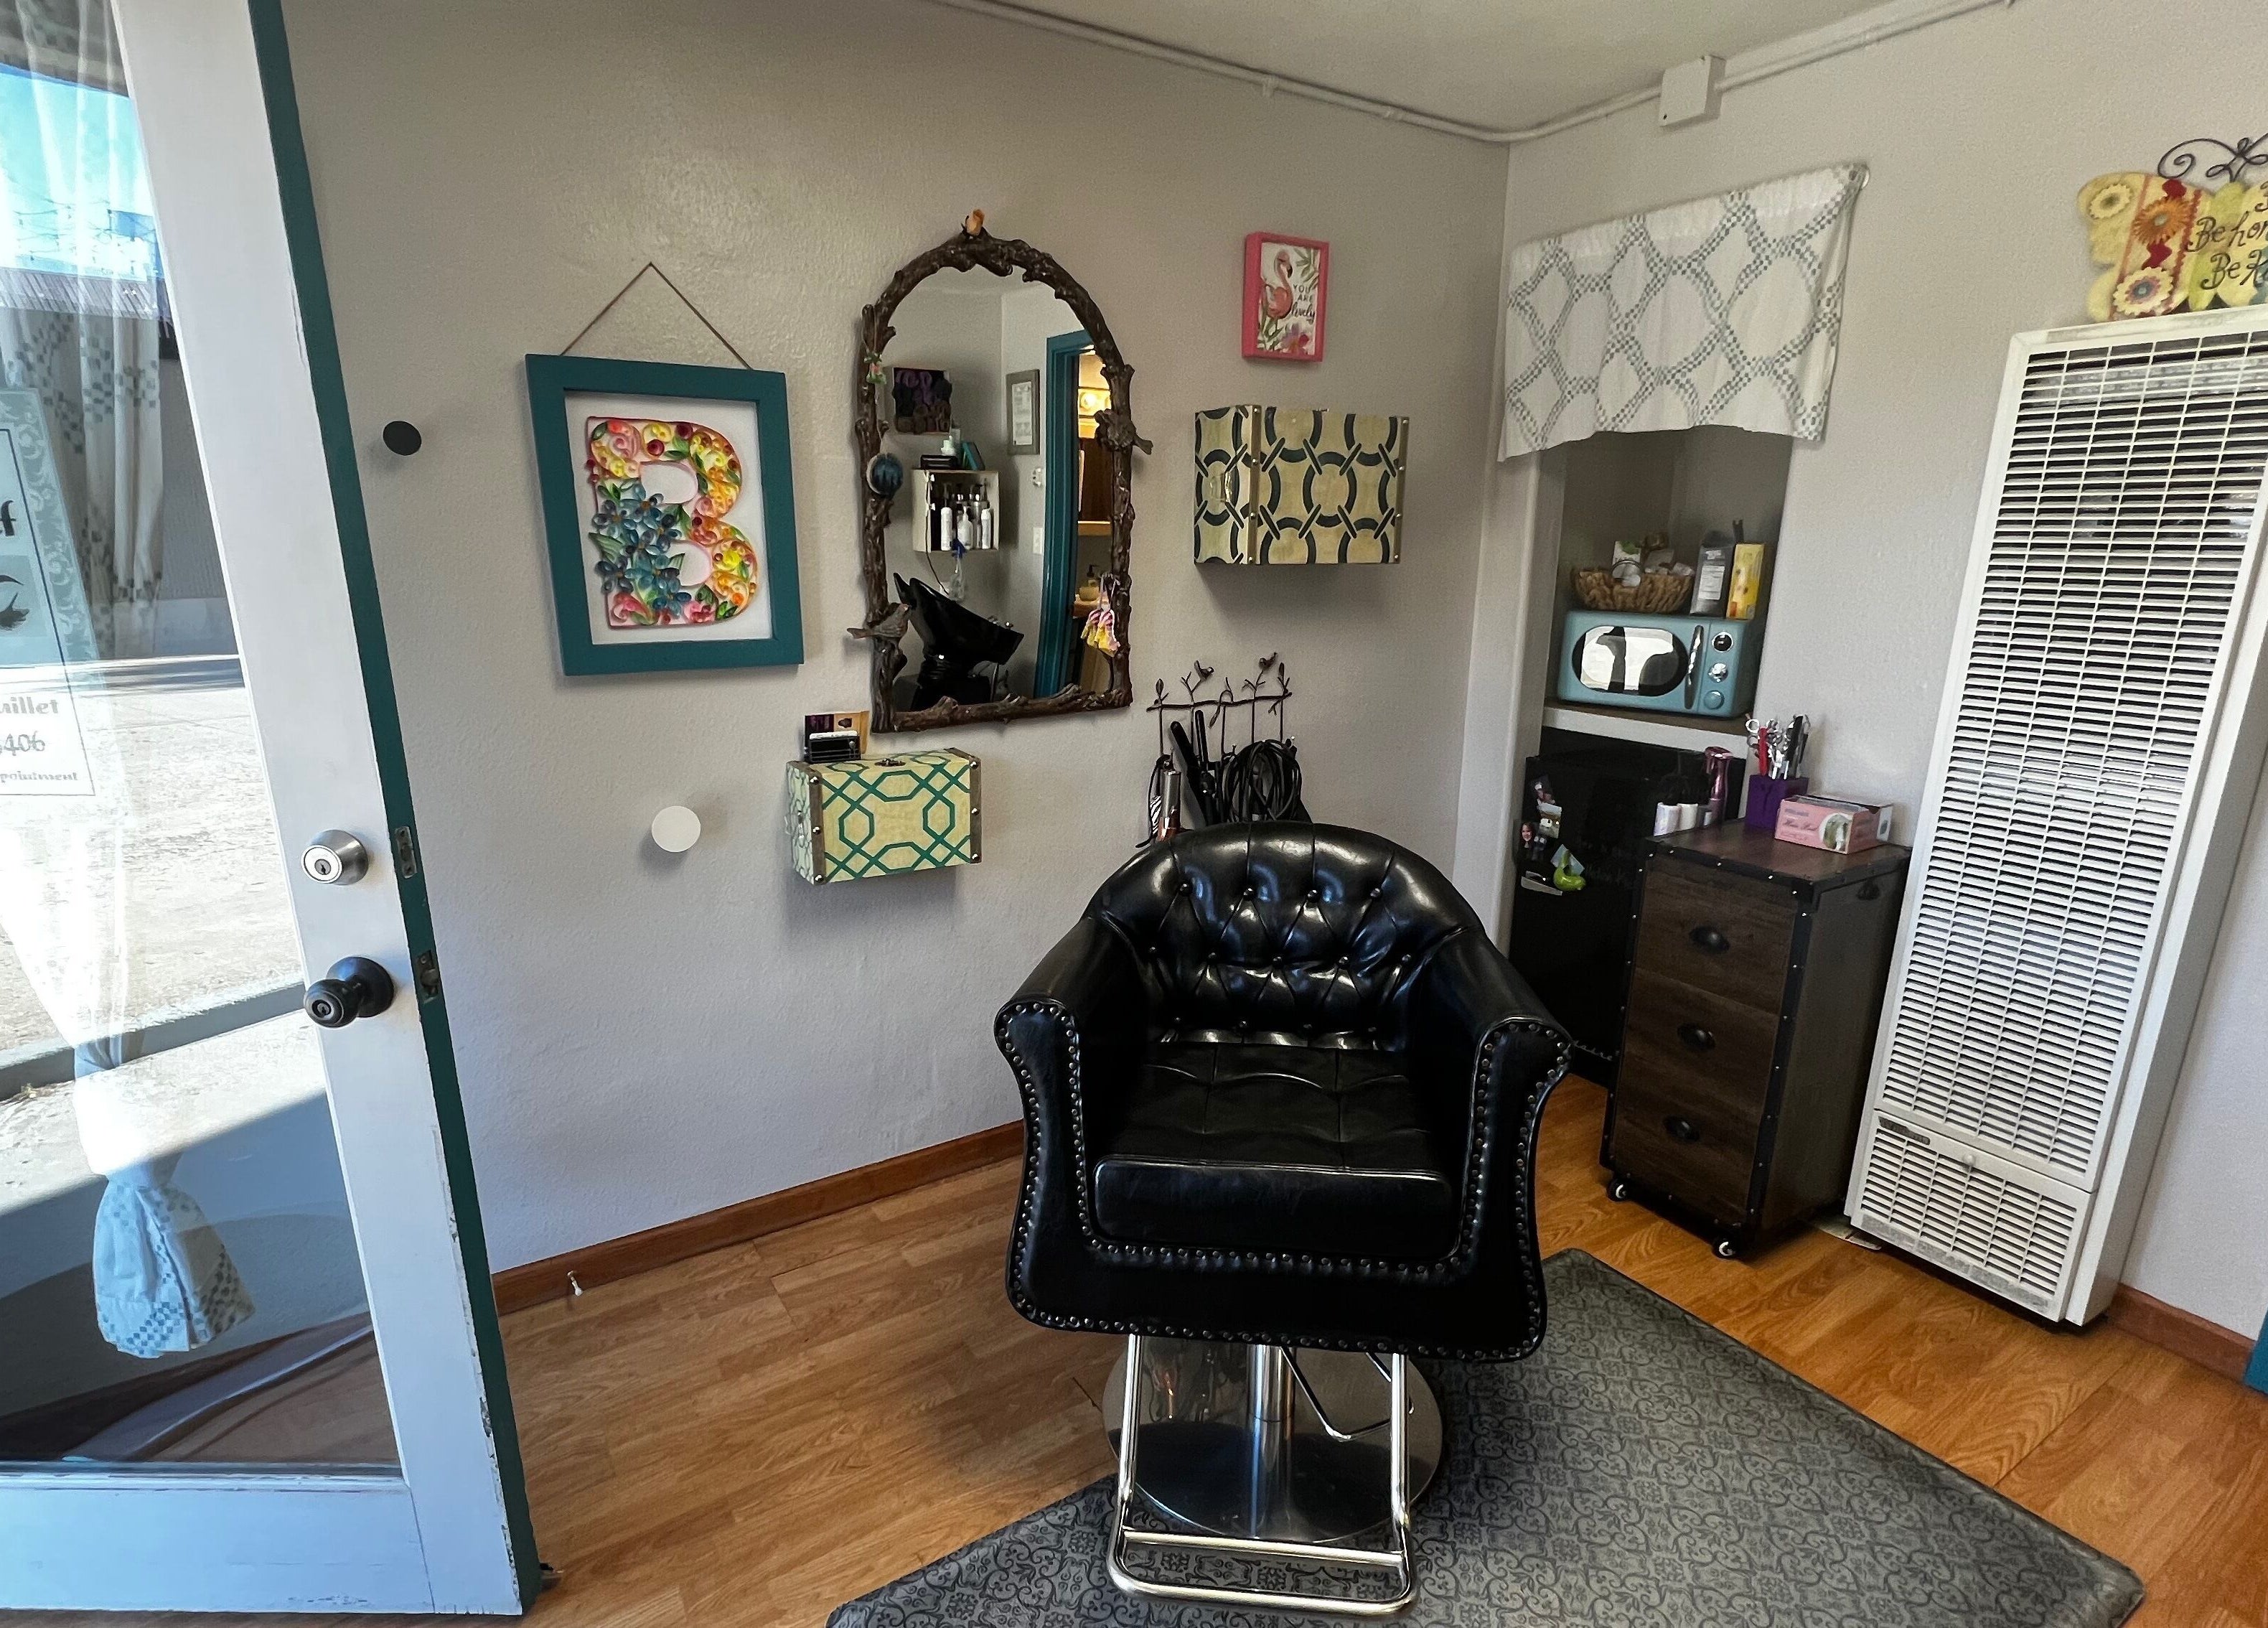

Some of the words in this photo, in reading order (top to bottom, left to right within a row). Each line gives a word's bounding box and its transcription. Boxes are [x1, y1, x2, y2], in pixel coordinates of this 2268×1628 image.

[2188, 216, 2225, 252] Be
[2201, 252, 2241, 289] Be
[0, 731, 45, 756] 406
